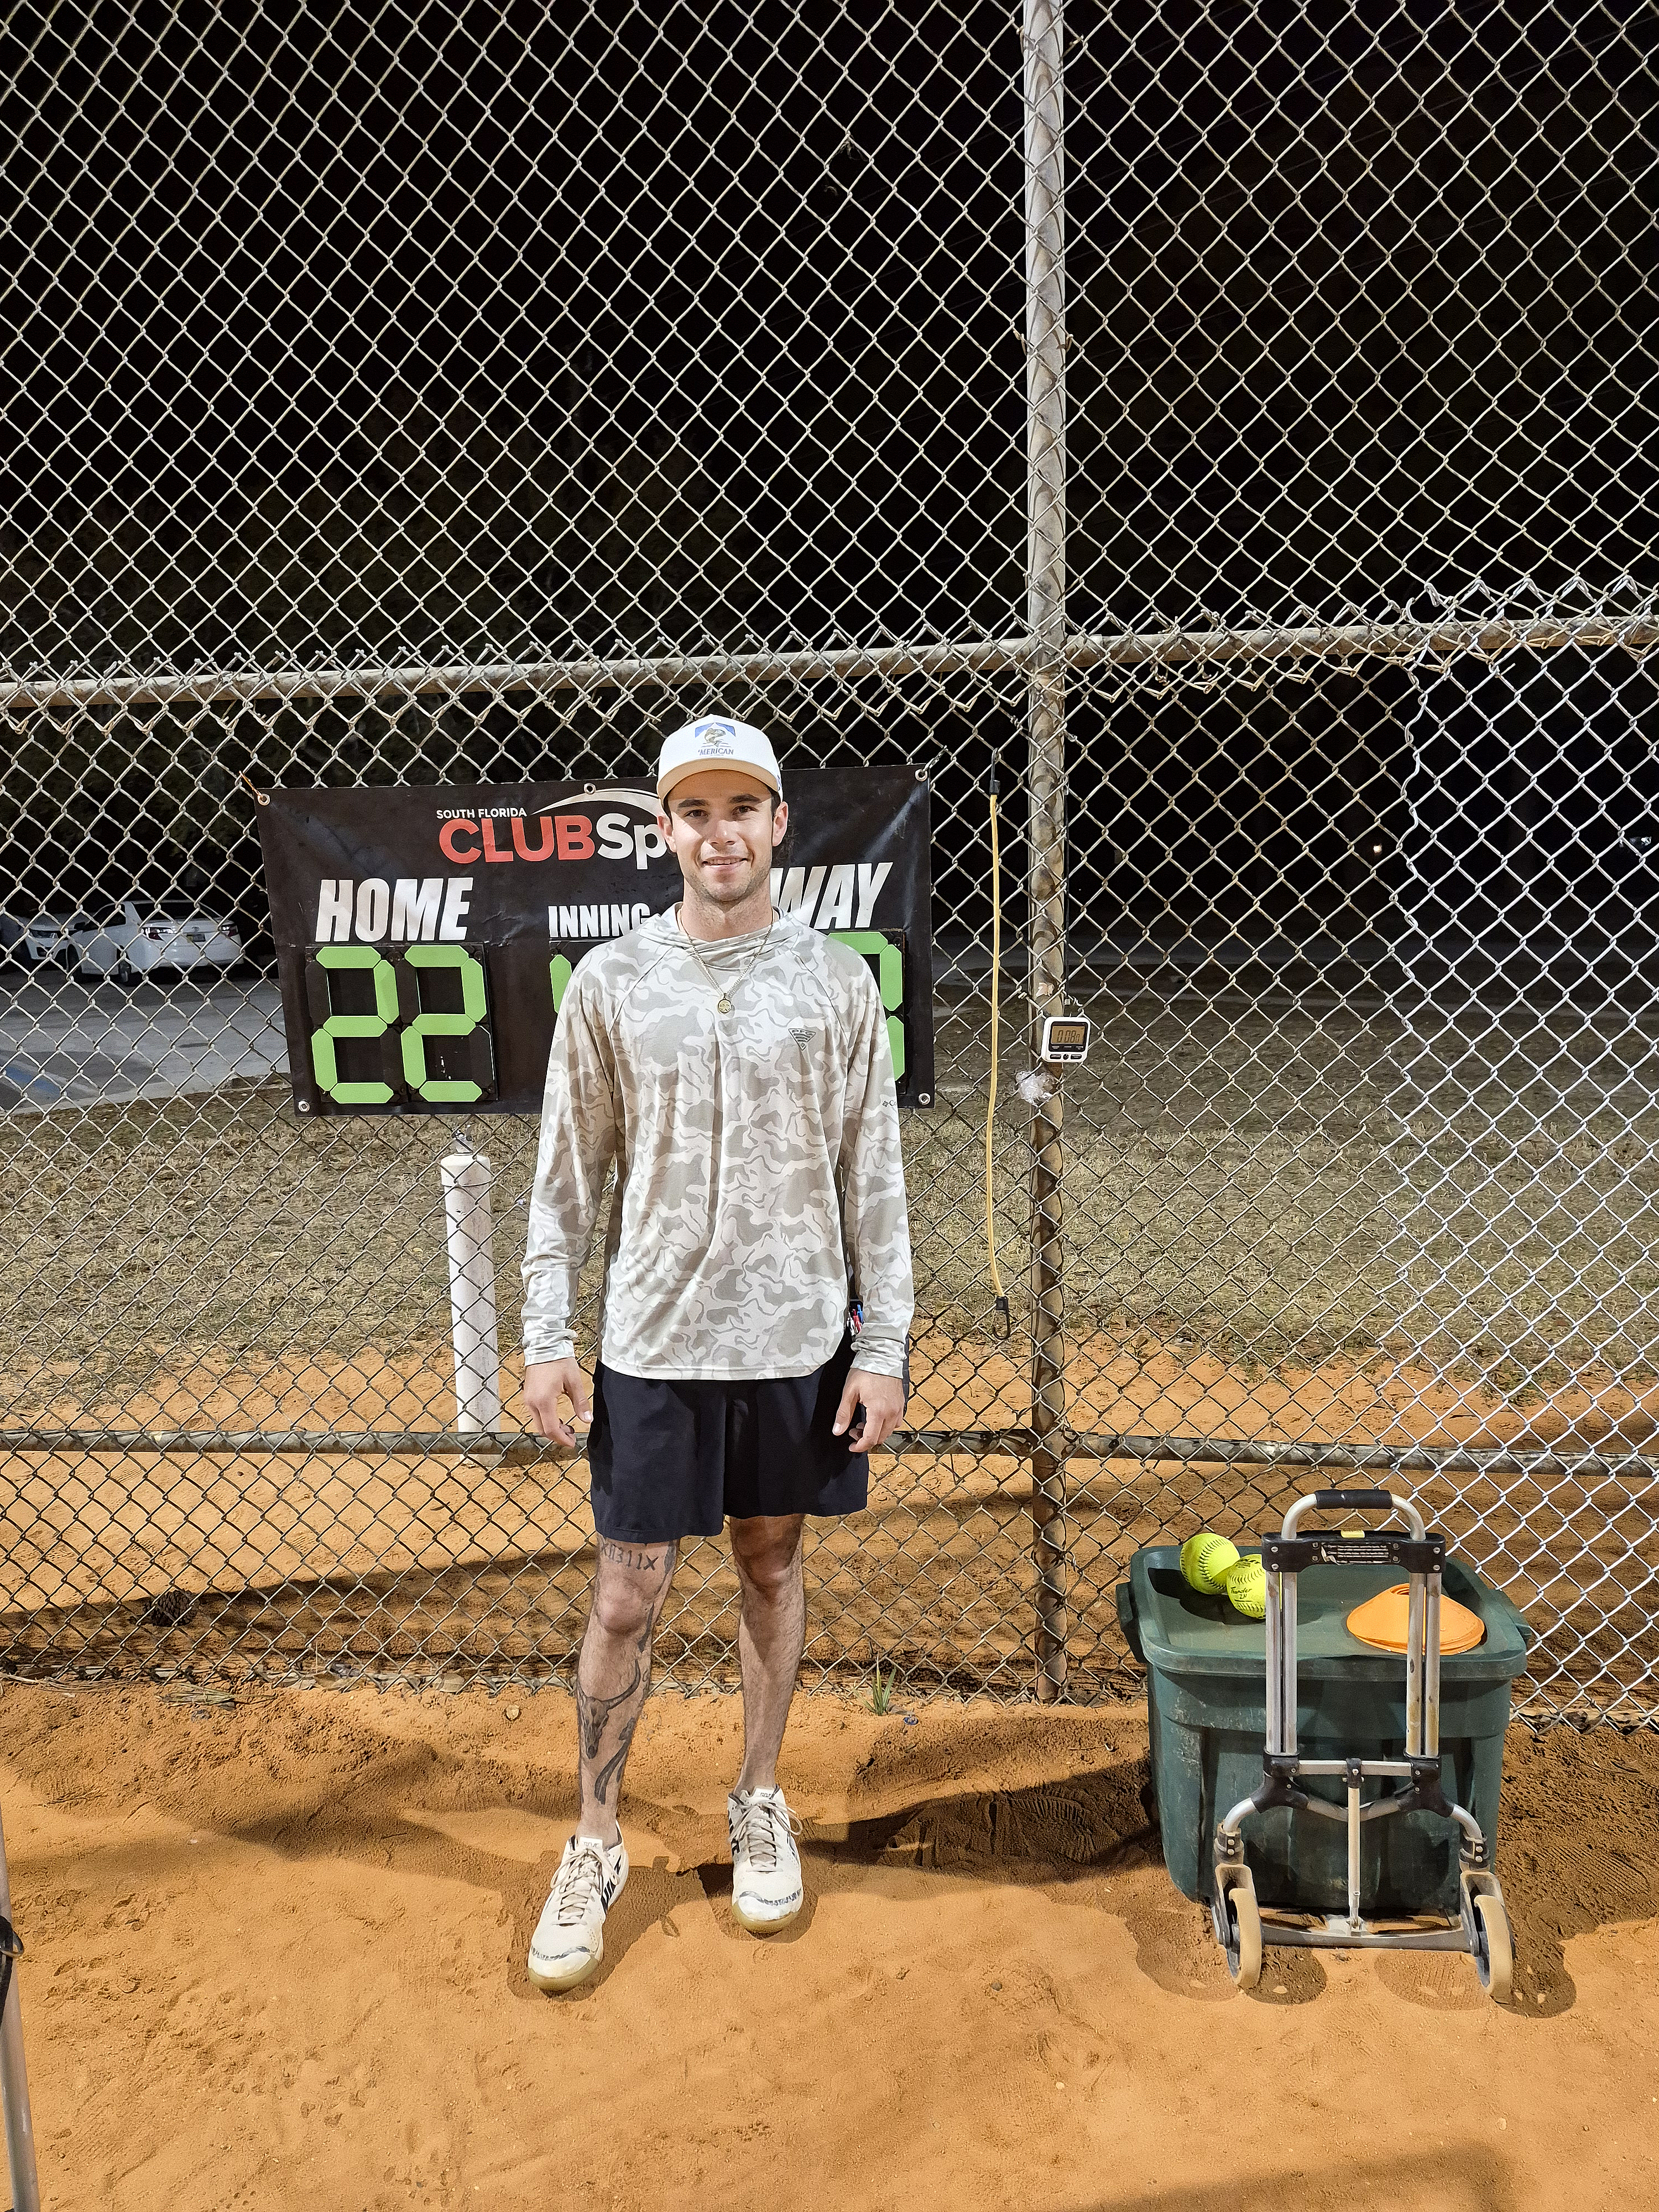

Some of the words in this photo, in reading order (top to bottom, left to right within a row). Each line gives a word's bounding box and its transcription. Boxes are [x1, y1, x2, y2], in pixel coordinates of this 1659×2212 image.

[698, 748, 734, 756] 'MERICAN
[436, 809, 475, 819] SOUTH
[478, 807, 528, 818] FLORIDA
[439, 813, 668, 870] CLUBSp
[315, 877, 473, 942] HOME
[770, 862, 894, 930] WAY
[311, 945, 487, 1104] 22
